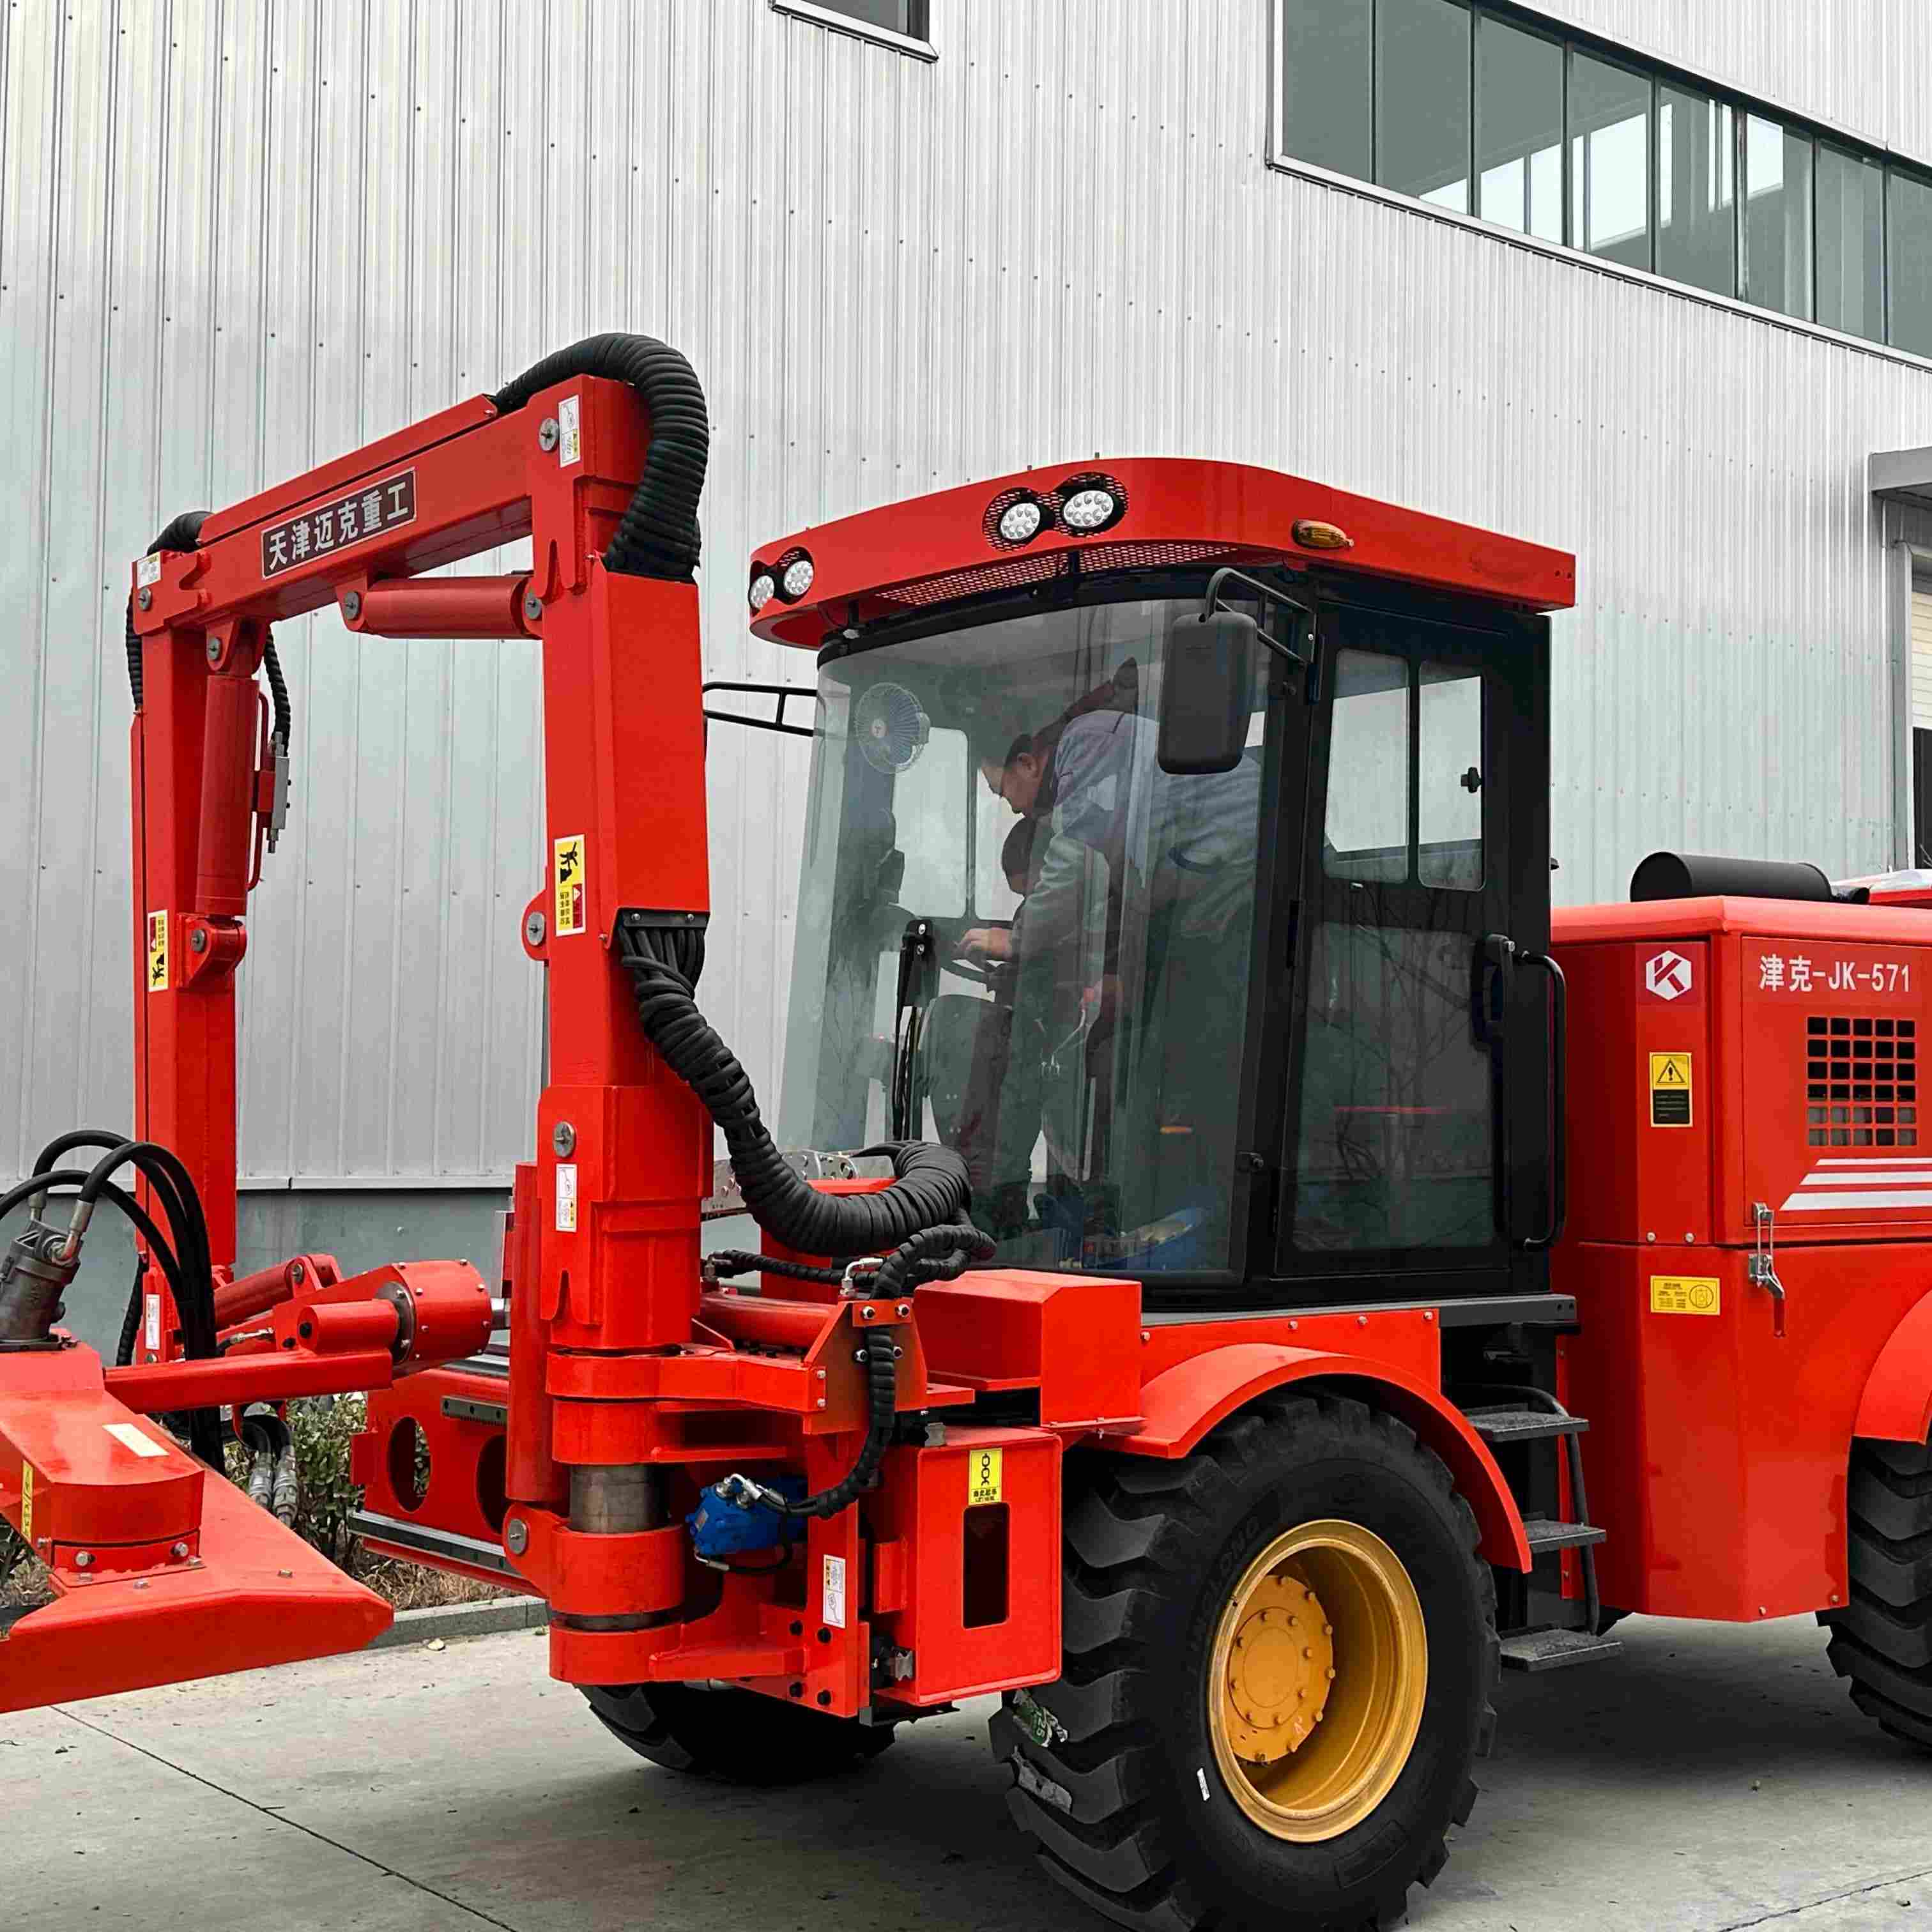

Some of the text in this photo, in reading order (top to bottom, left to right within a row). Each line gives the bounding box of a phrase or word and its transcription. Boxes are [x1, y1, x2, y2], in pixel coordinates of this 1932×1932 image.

[269, 482, 409, 570] 天津迈克重工
[1759, 954, 1910, 992] 津克-JK-571
